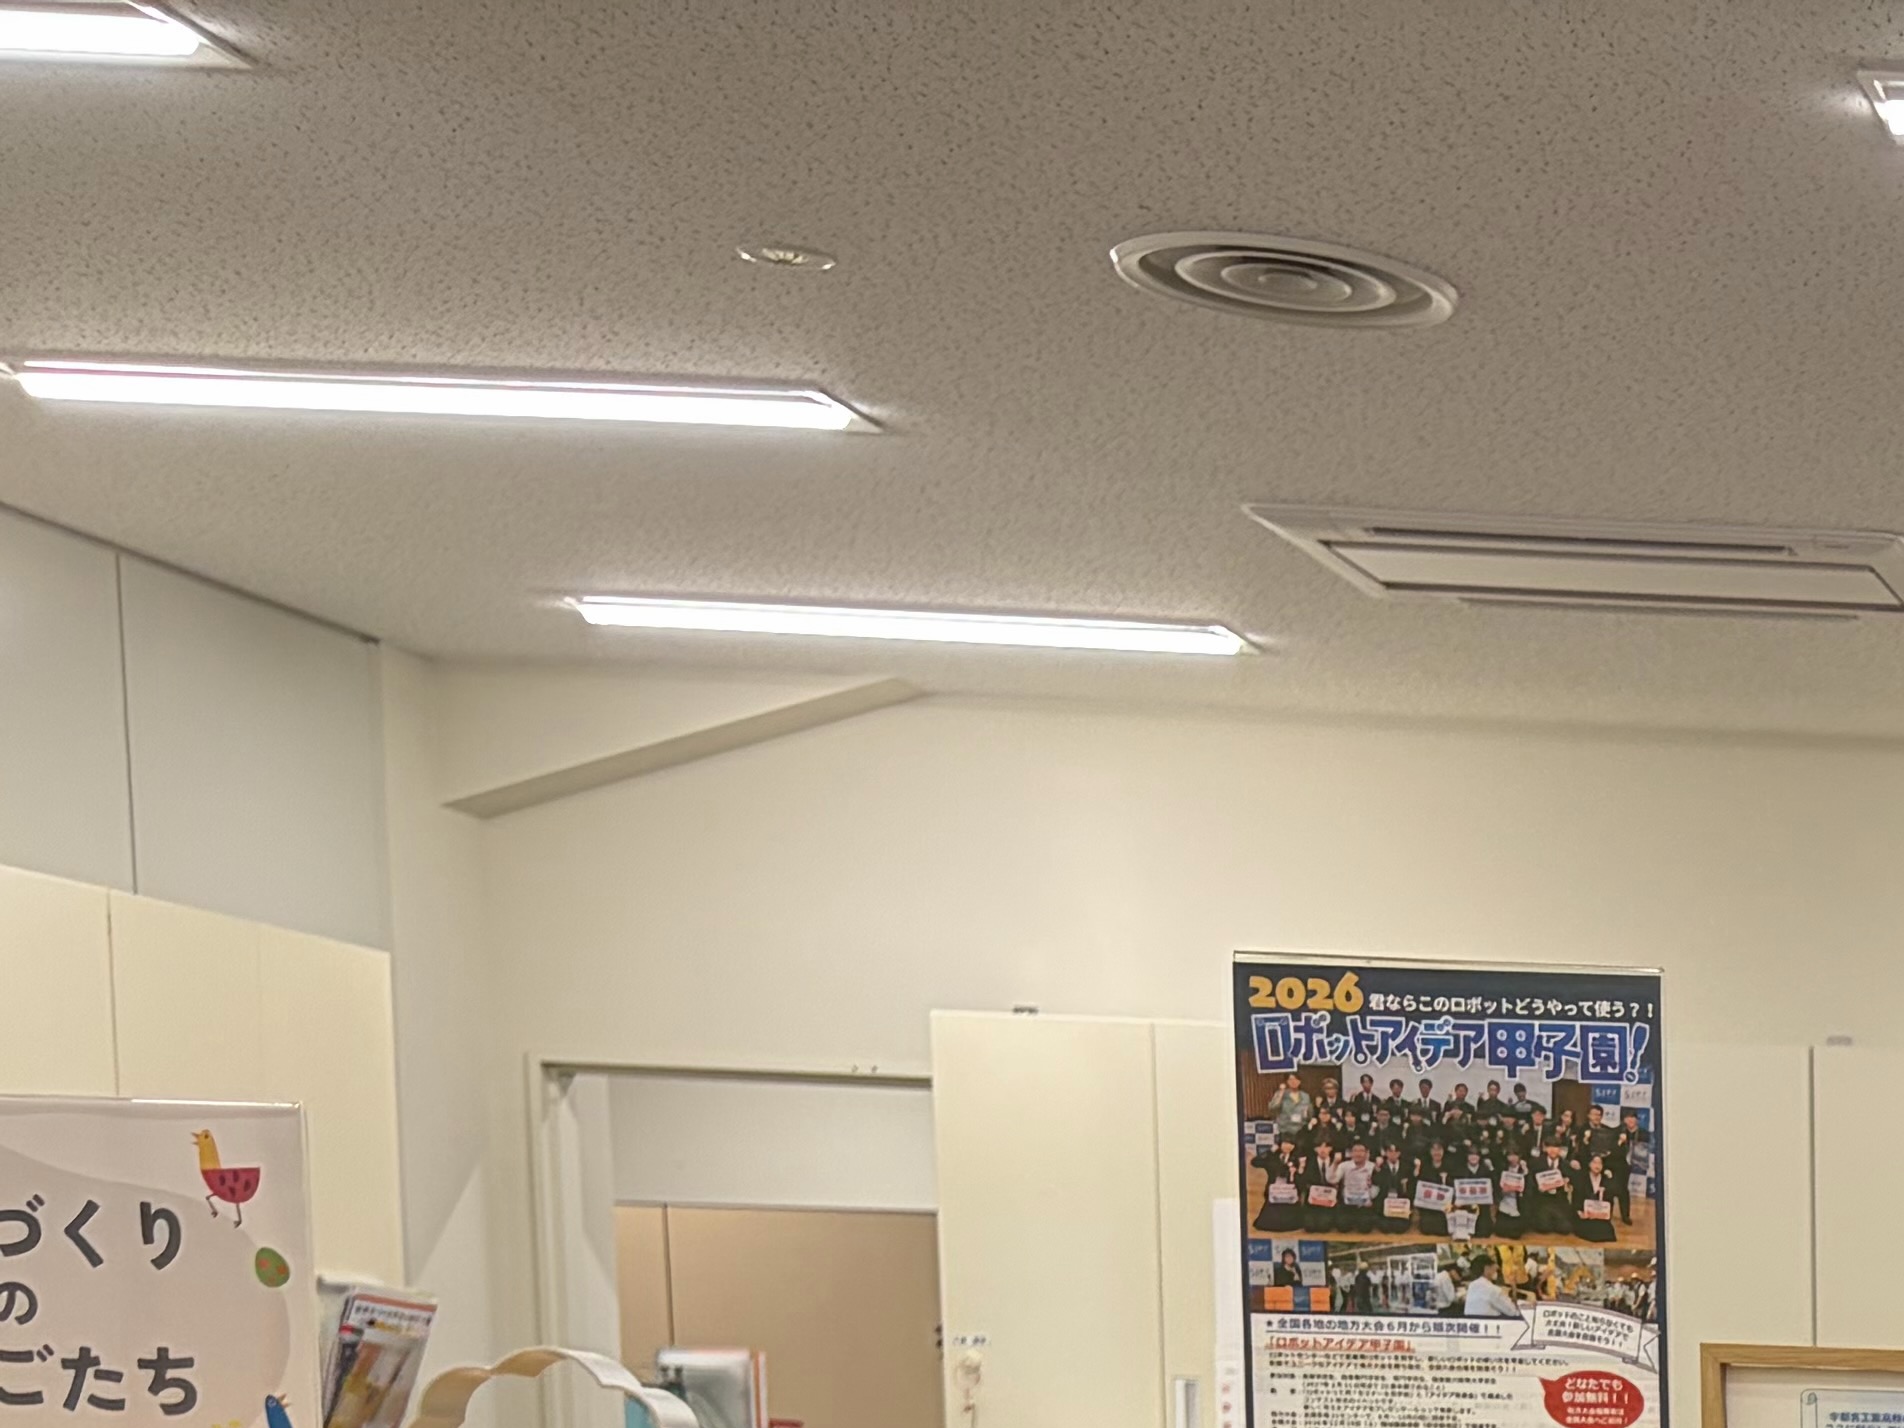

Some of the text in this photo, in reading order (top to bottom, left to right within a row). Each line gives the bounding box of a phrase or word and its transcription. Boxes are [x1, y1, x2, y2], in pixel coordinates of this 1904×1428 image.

[1248, 970, 1364, 1014] 2026
[1368, 993, 1655, 1019] 君ならこのロボットどうやって使う？！
[0, 1194, 182, 1270] づくり
[0, 1281, 38, 1325] の
[0, 1344, 198, 1417] ごたち
